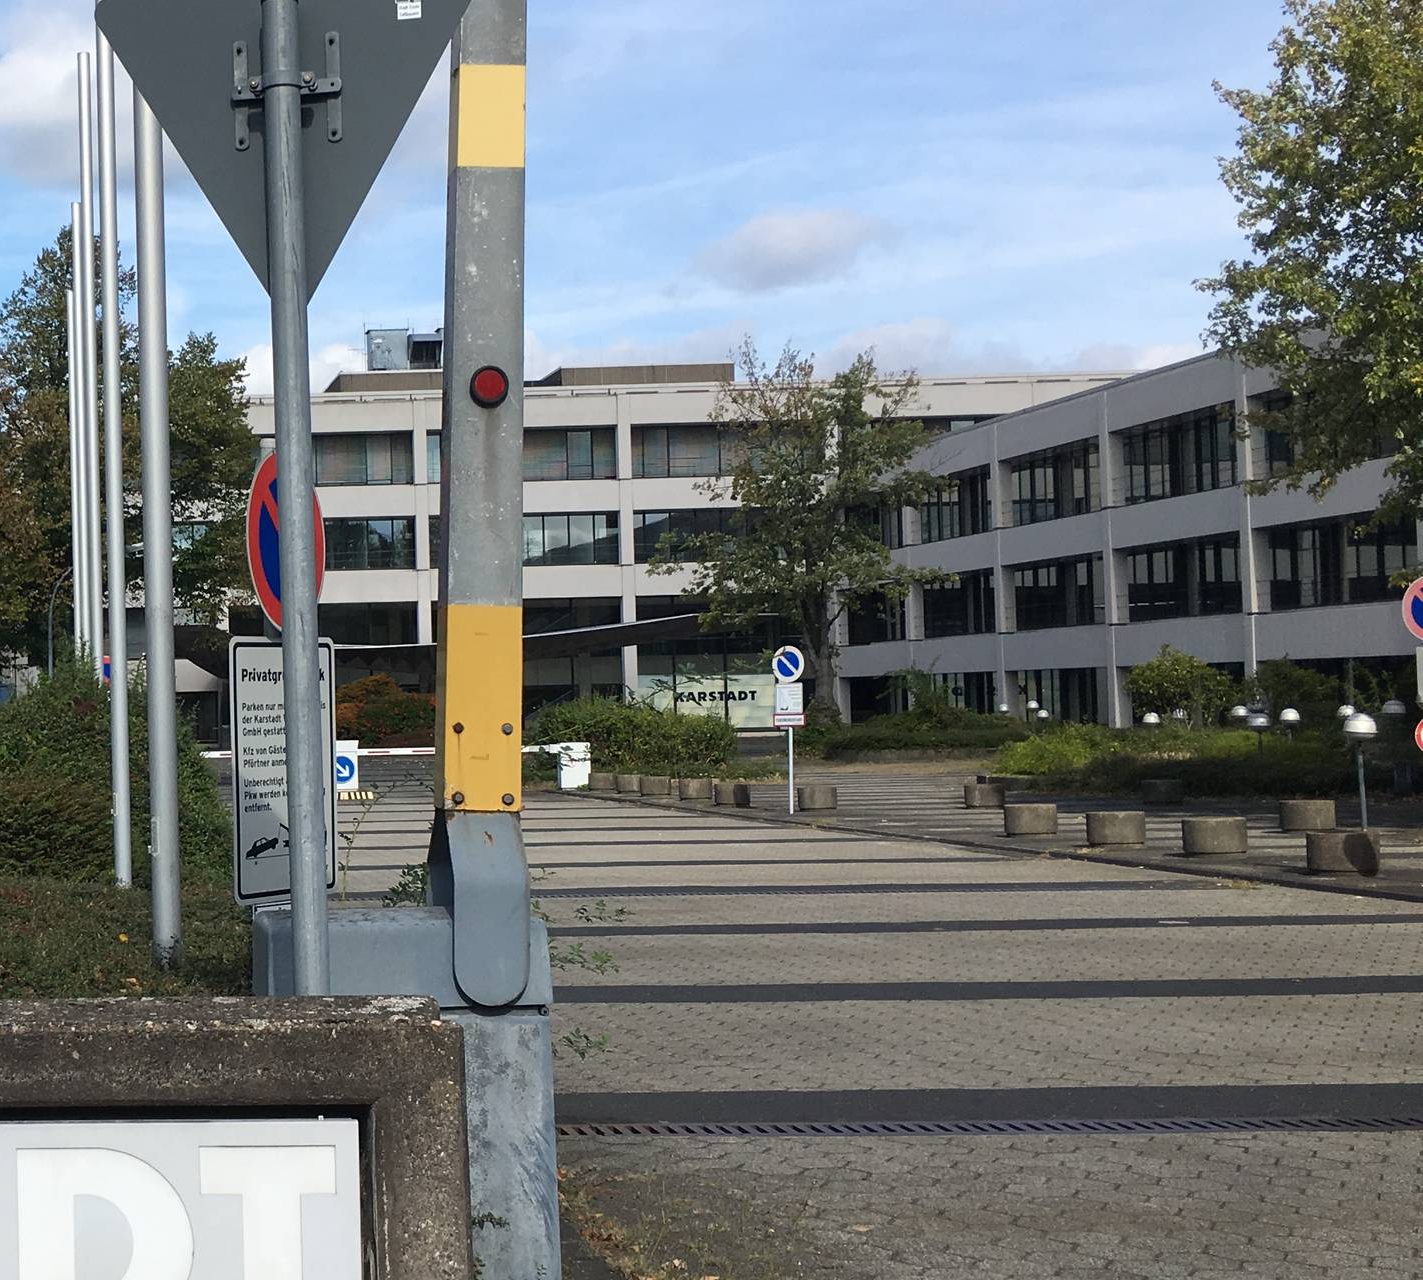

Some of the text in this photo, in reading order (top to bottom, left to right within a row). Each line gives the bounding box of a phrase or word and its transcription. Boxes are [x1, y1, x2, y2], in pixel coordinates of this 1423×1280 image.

[241, 702, 264, 711] Parken
[265, 703, 276, 711] nur
[242, 714, 282, 724] der Karstadt
[242, 726, 286, 737] GmbH gestatt
[243, 746, 254, 755] Kfz
[268, 745, 286, 754] Gäste
[243, 759, 270, 768] Pförtner
[244, 777, 284, 787] Unberechtigt
[244, 791, 257, 800] Pkw
[259, 790, 281, 799] werden
[244, 802, 272, 813] entfernt.
